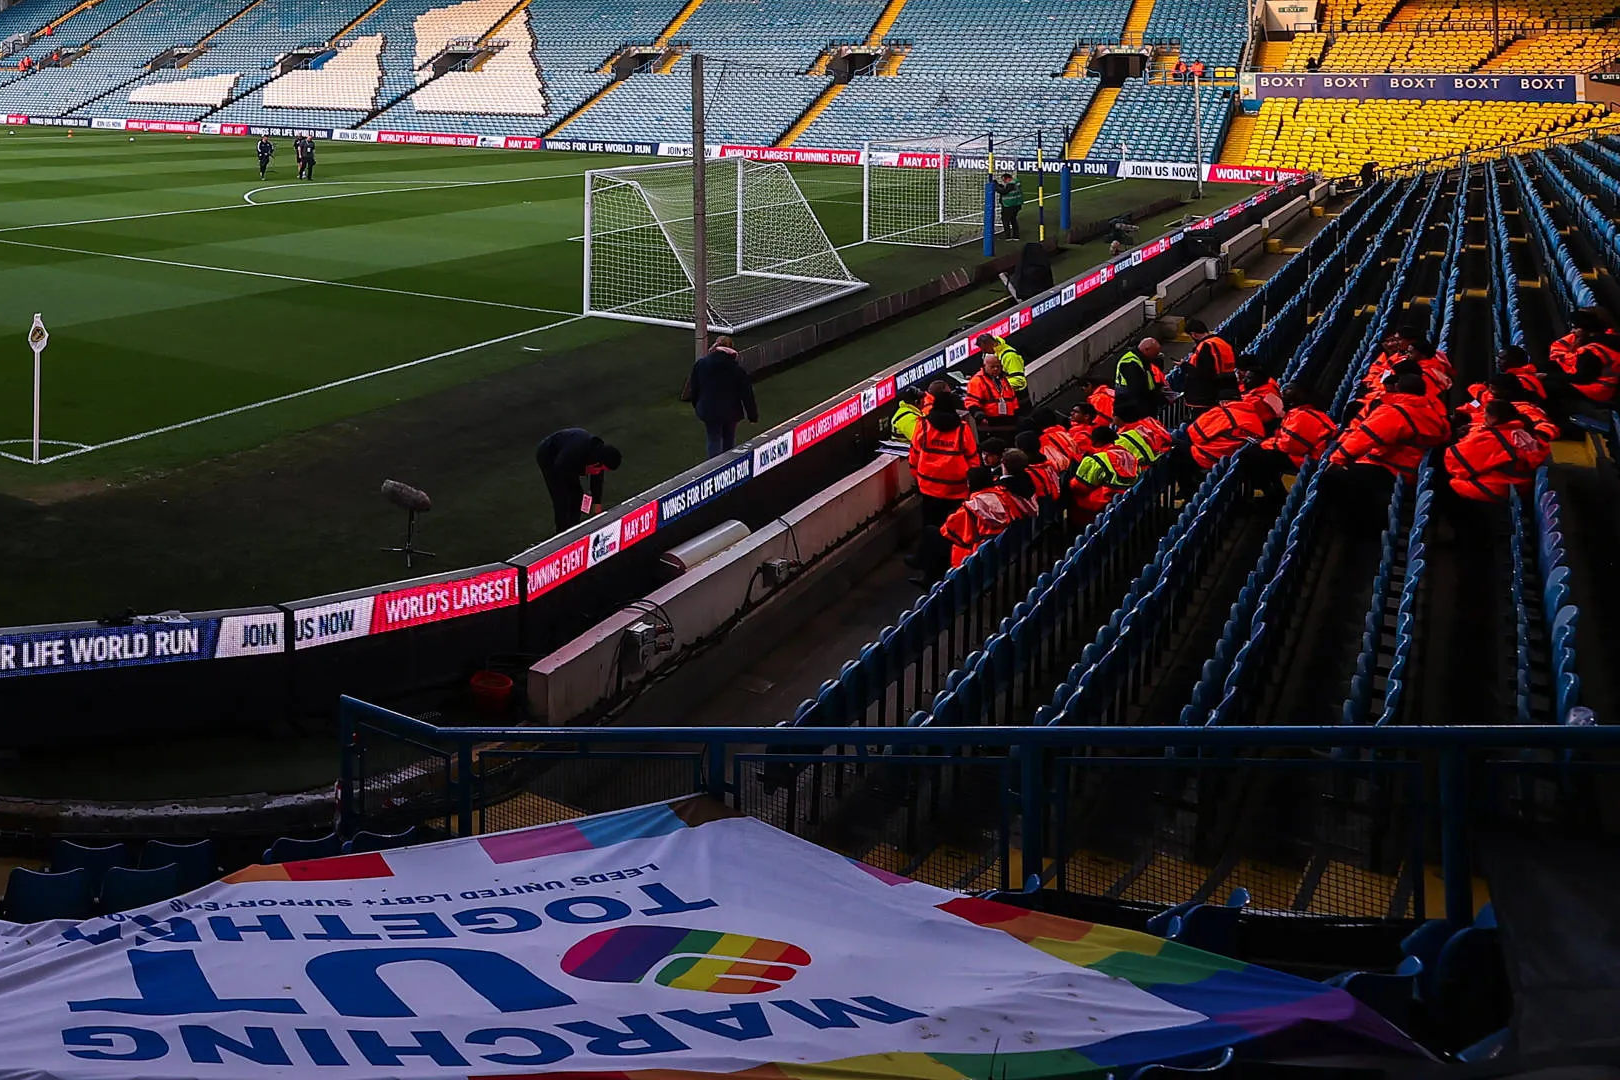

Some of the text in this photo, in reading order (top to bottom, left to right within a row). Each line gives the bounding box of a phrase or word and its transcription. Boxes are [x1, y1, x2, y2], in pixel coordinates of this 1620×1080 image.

[1260, 77, 1306, 88] BOXT
[1324, 77, 1370, 88] BOXT
[1390, 77, 1437, 88] BOXT
[1454, 77, 1500, 88] BOXT
[1520, 78, 1565, 89] BOXT
[381, 134, 476, 146] WORLD'S LARGEST RUNNING EVENT
[508, 140, 522, 148] MAY
[546, 142, 652, 154] WINGS FOR LIFE WORLD RUN
[760, 150, 792, 160] LARGEST
[795, 151, 830, 162] RUNNING
[832, 153, 856, 164] EVENT
[903, 158, 940, 167] MAY 10
[957, 159, 990, 170] WINGS
[995, 160, 1015, 171] FOR
[1018, 161, 1038, 172] LIFE
[1085, 162, 1108, 174] RUN
[1131, 166, 1197, 178] JOIN US NOW
[796, 426, 814, 447] WORLD'S
[816, 418, 832, 437] LARGEST
[849, 400, 860, 418] EVENT
[770, 447, 776, 461] US
[778, 440, 788, 457] NOW
[662, 459, 750, 520] WINGS FOR LIFE WORLD RUN
[624, 520, 639, 541] MAY
[562, 546, 584, 575] EVENT
[386, 577, 510, 623] WORLD'S LARGEST
[242, 610, 354, 648] JOIN US NOW
[22, 640, 64, 667] LIFE
[70, 633, 148, 663] WORLD
[154, 628, 198, 655] RUN
[571, 863, 660, 887] LEEDS
[362, 890, 452, 907] LGBT+
[453, 880, 565, 902] UNITED
[61, 994, 929, 1067] MARCHING
